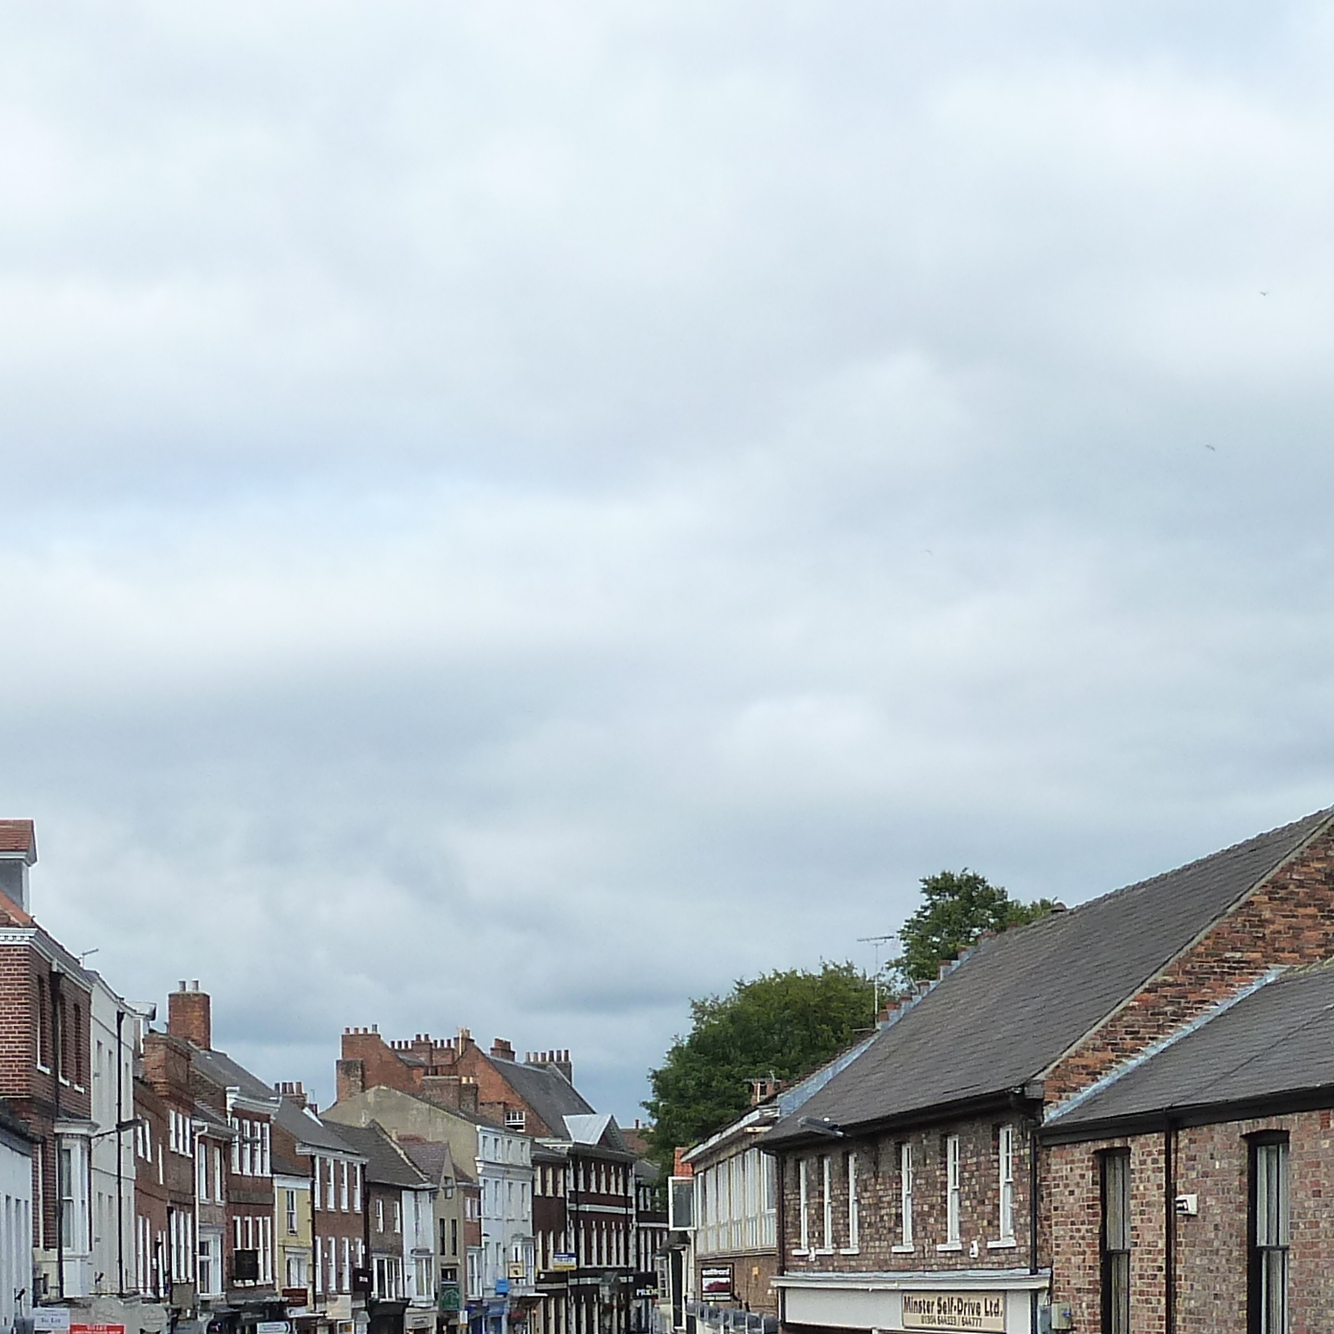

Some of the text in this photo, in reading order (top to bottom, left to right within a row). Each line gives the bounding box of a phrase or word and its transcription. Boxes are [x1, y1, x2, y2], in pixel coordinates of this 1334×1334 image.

[903, 1296, 1004, 1317] Minster Self-Drive Ltd.
